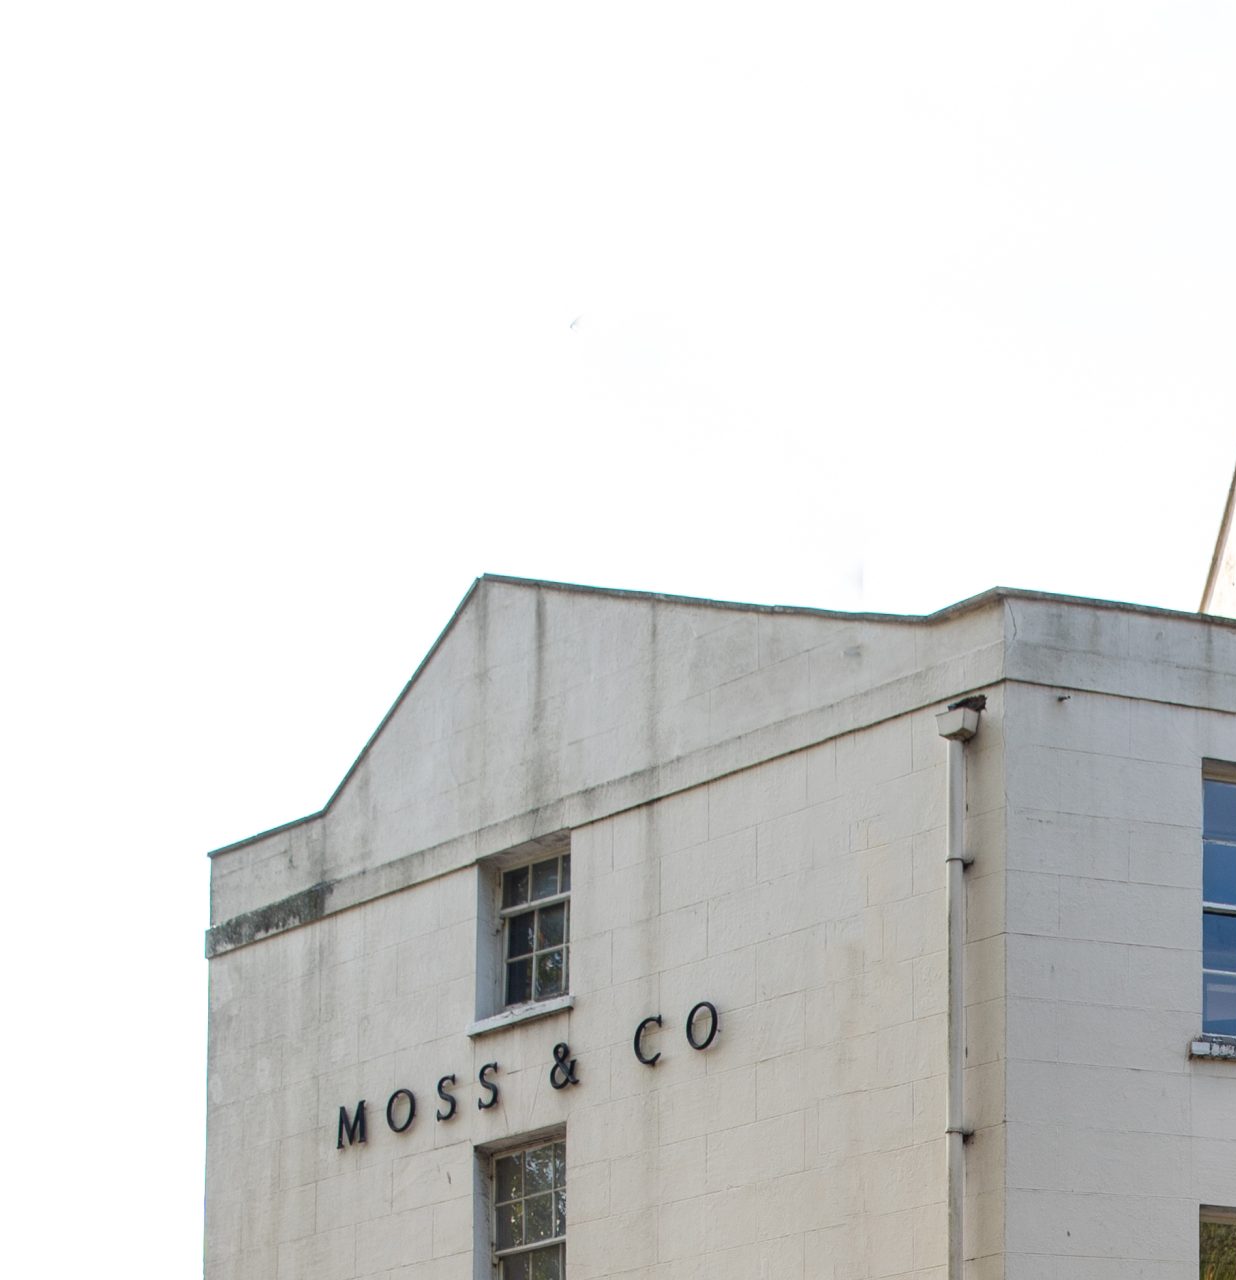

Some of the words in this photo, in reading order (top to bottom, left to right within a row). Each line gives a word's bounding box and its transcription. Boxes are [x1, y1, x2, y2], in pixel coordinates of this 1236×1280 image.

[336, 1062, 498, 1150] MOSS
[550, 1042, 580, 1091] &
[634, 1001, 720, 1067] CO
